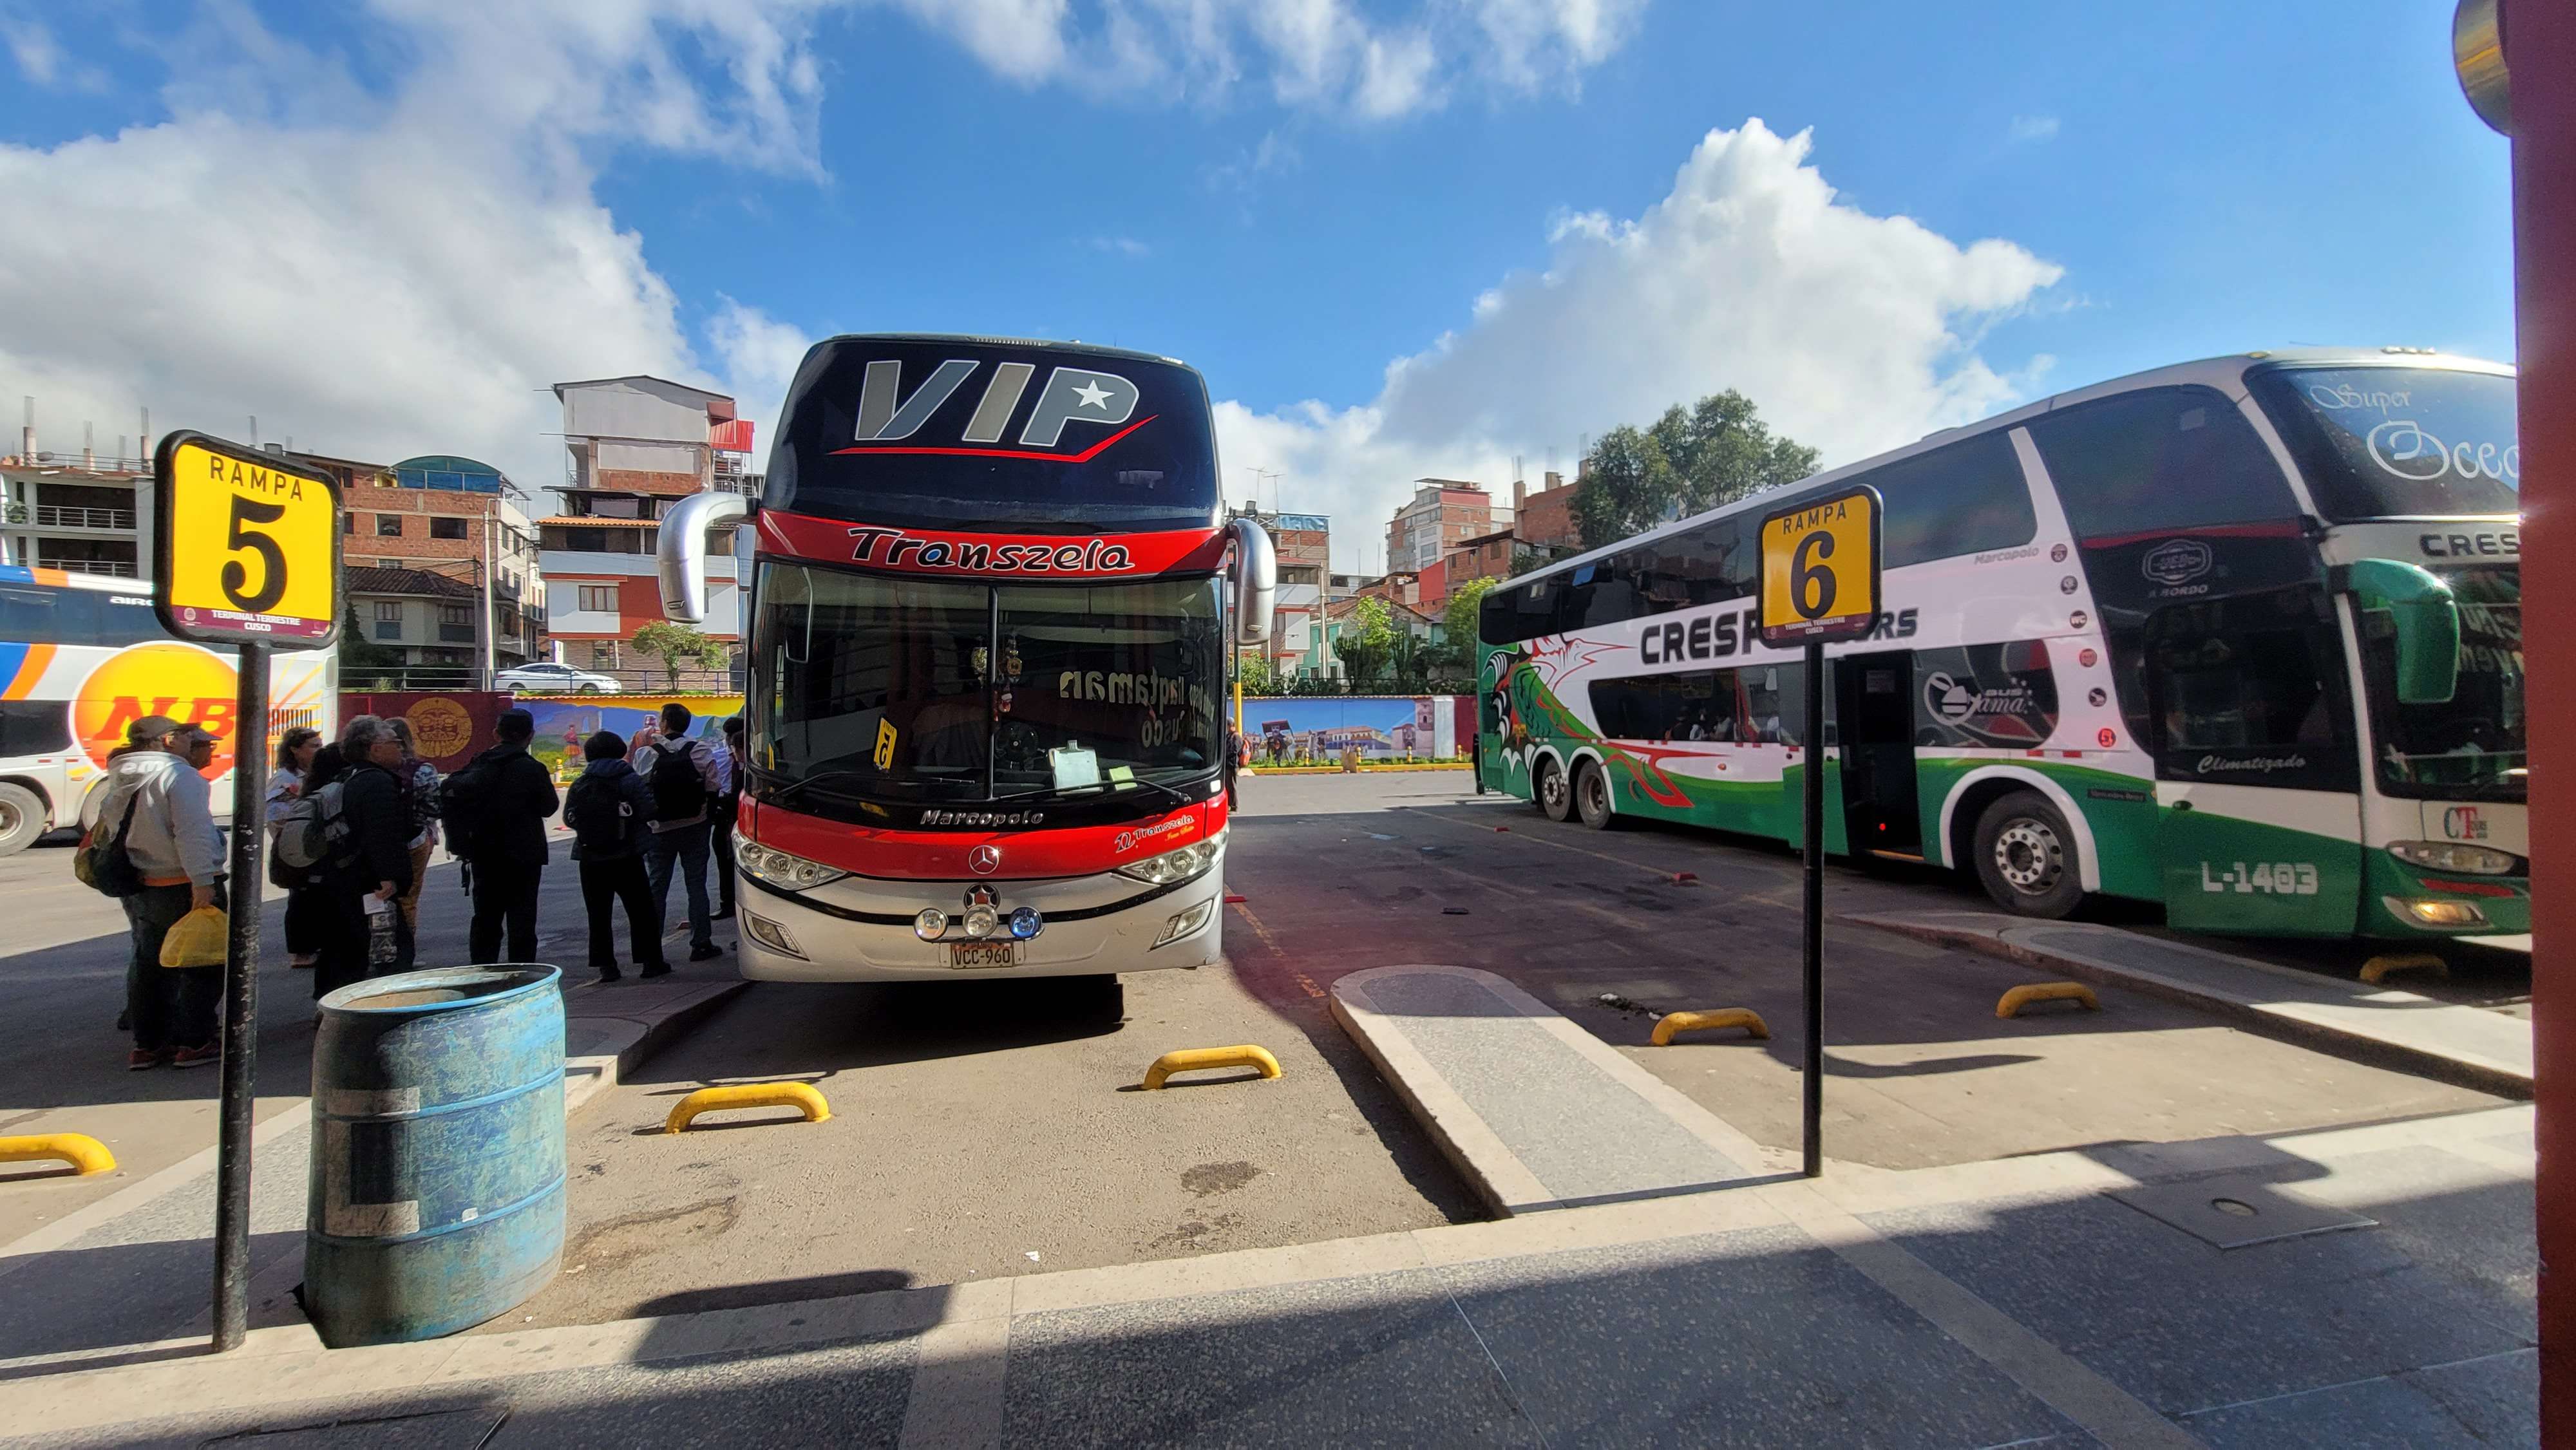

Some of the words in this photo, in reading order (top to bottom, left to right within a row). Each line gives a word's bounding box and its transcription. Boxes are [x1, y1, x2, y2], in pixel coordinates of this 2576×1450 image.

[855, 360, 1139, 446] VIP
[2309, 383, 2412, 416] Super
[211, 456, 302, 501] RAMPA
[1783, 502, 1846, 534] RAMPA
[221, 493, 287, 612] 5
[848, 527, 1135, 572] Transzela
[1974, 546, 2040, 565] Marcopolo
[2420, 534, 2519, 556] CRES
[1791, 530, 1837, 619] 6
[211, 610, 255, 623] TERMINAL
[256, 612, 301, 626] TERRESTRE
[244, 621, 272, 632] CUSCO
[1785, 619, 1812, 630] TERMINAL
[1813, 617, 1845, 626] TERRESTRE
[1641, 609, 1757, 665] CRESP
[1985, 688, 2023, 697] BUS
[2197, 753, 2306, 774] Climatizado
[921, 809, 1044, 826] Marcopolo
[954, 948, 1011, 965] VCC-960
